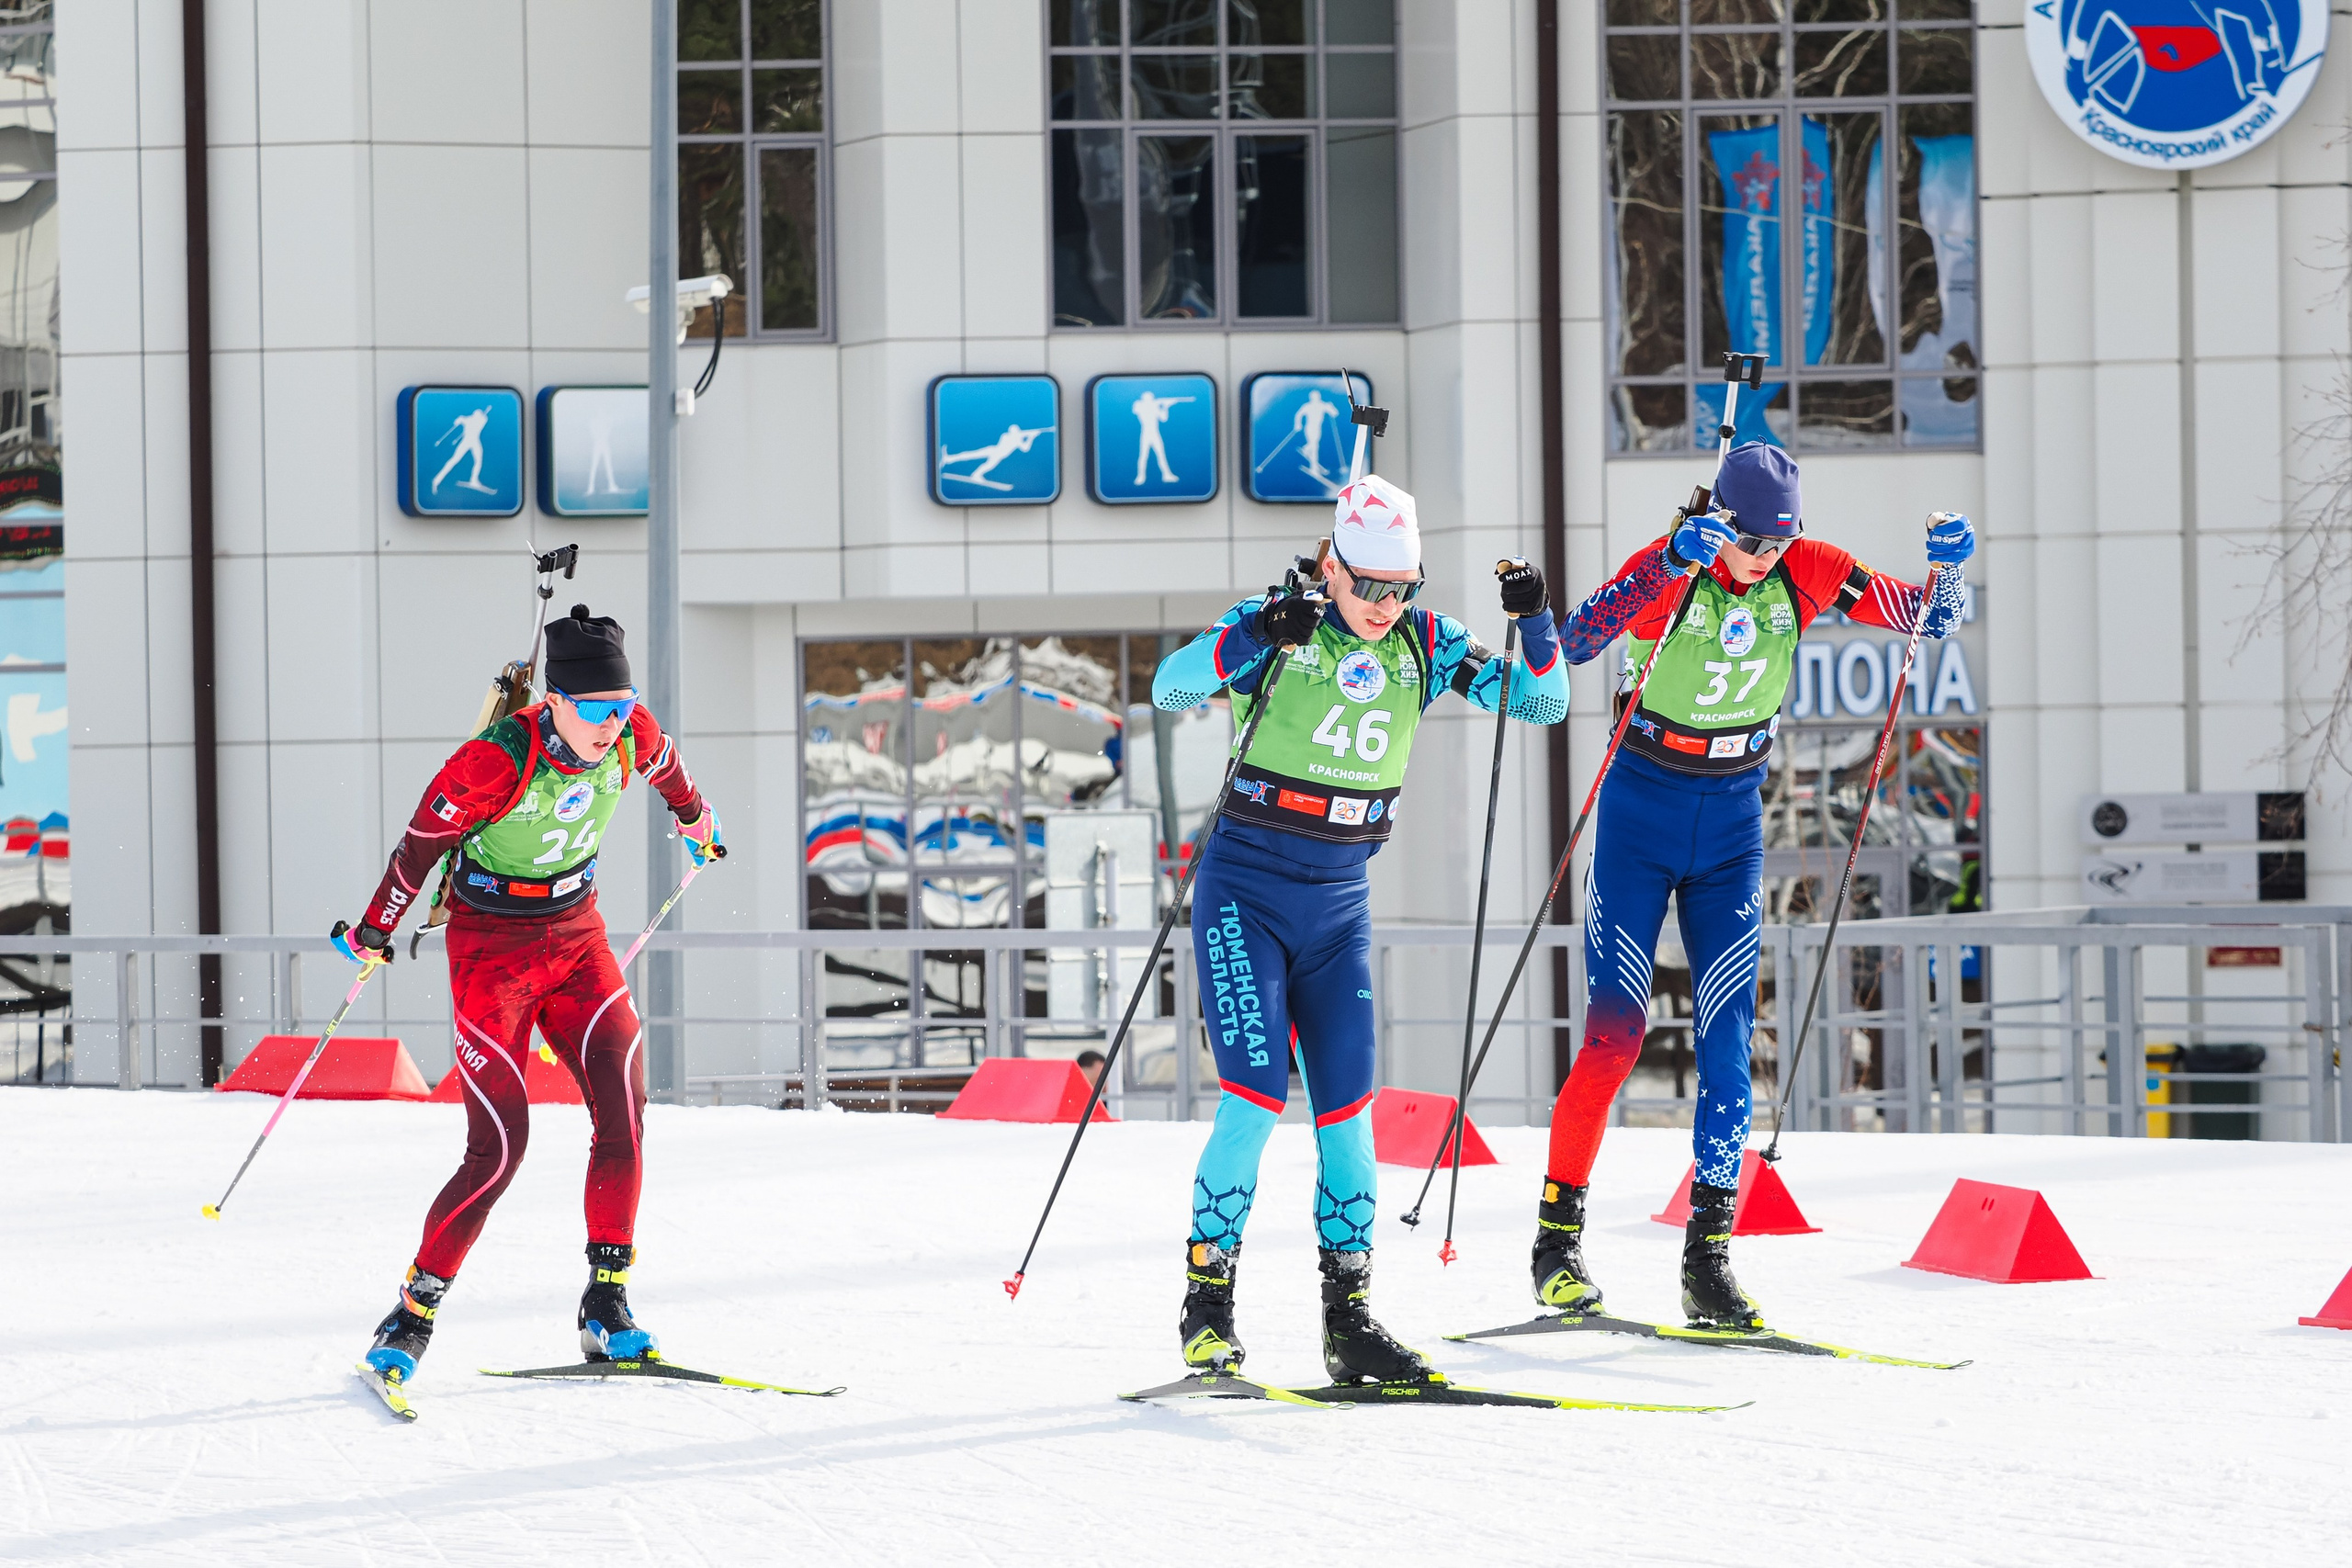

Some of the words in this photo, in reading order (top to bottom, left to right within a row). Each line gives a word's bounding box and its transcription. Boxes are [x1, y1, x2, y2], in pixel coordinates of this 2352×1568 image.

[2080, 107, 2228, 162] Красноярский
[2232, 101, 2278, 142] край
[1505, 569, 1532, 581] MOAX
[1567, 572, 1636, 624] MOAX
[1499, 684, 1509, 710] MOAX
[1693, 658, 1769, 706] 37
[1792, 637, 1977, 718] ЛОНА
[1311, 704, 1393, 762] 46
[1690, 708, 1756, 723] КРАСНОЯРСК
[1307, 763, 1381, 784] КРАСНОЯРСК
[533, 818, 598, 865] 24
[1205, 927, 1240, 1047] ОБЛАСТЬ
[1219, 901, 1270, 1067] ТЮМЕНСКАЯ
[600, 1247, 620, 1257] 174
[1560, 1316, 1583, 1325] FISCHER
